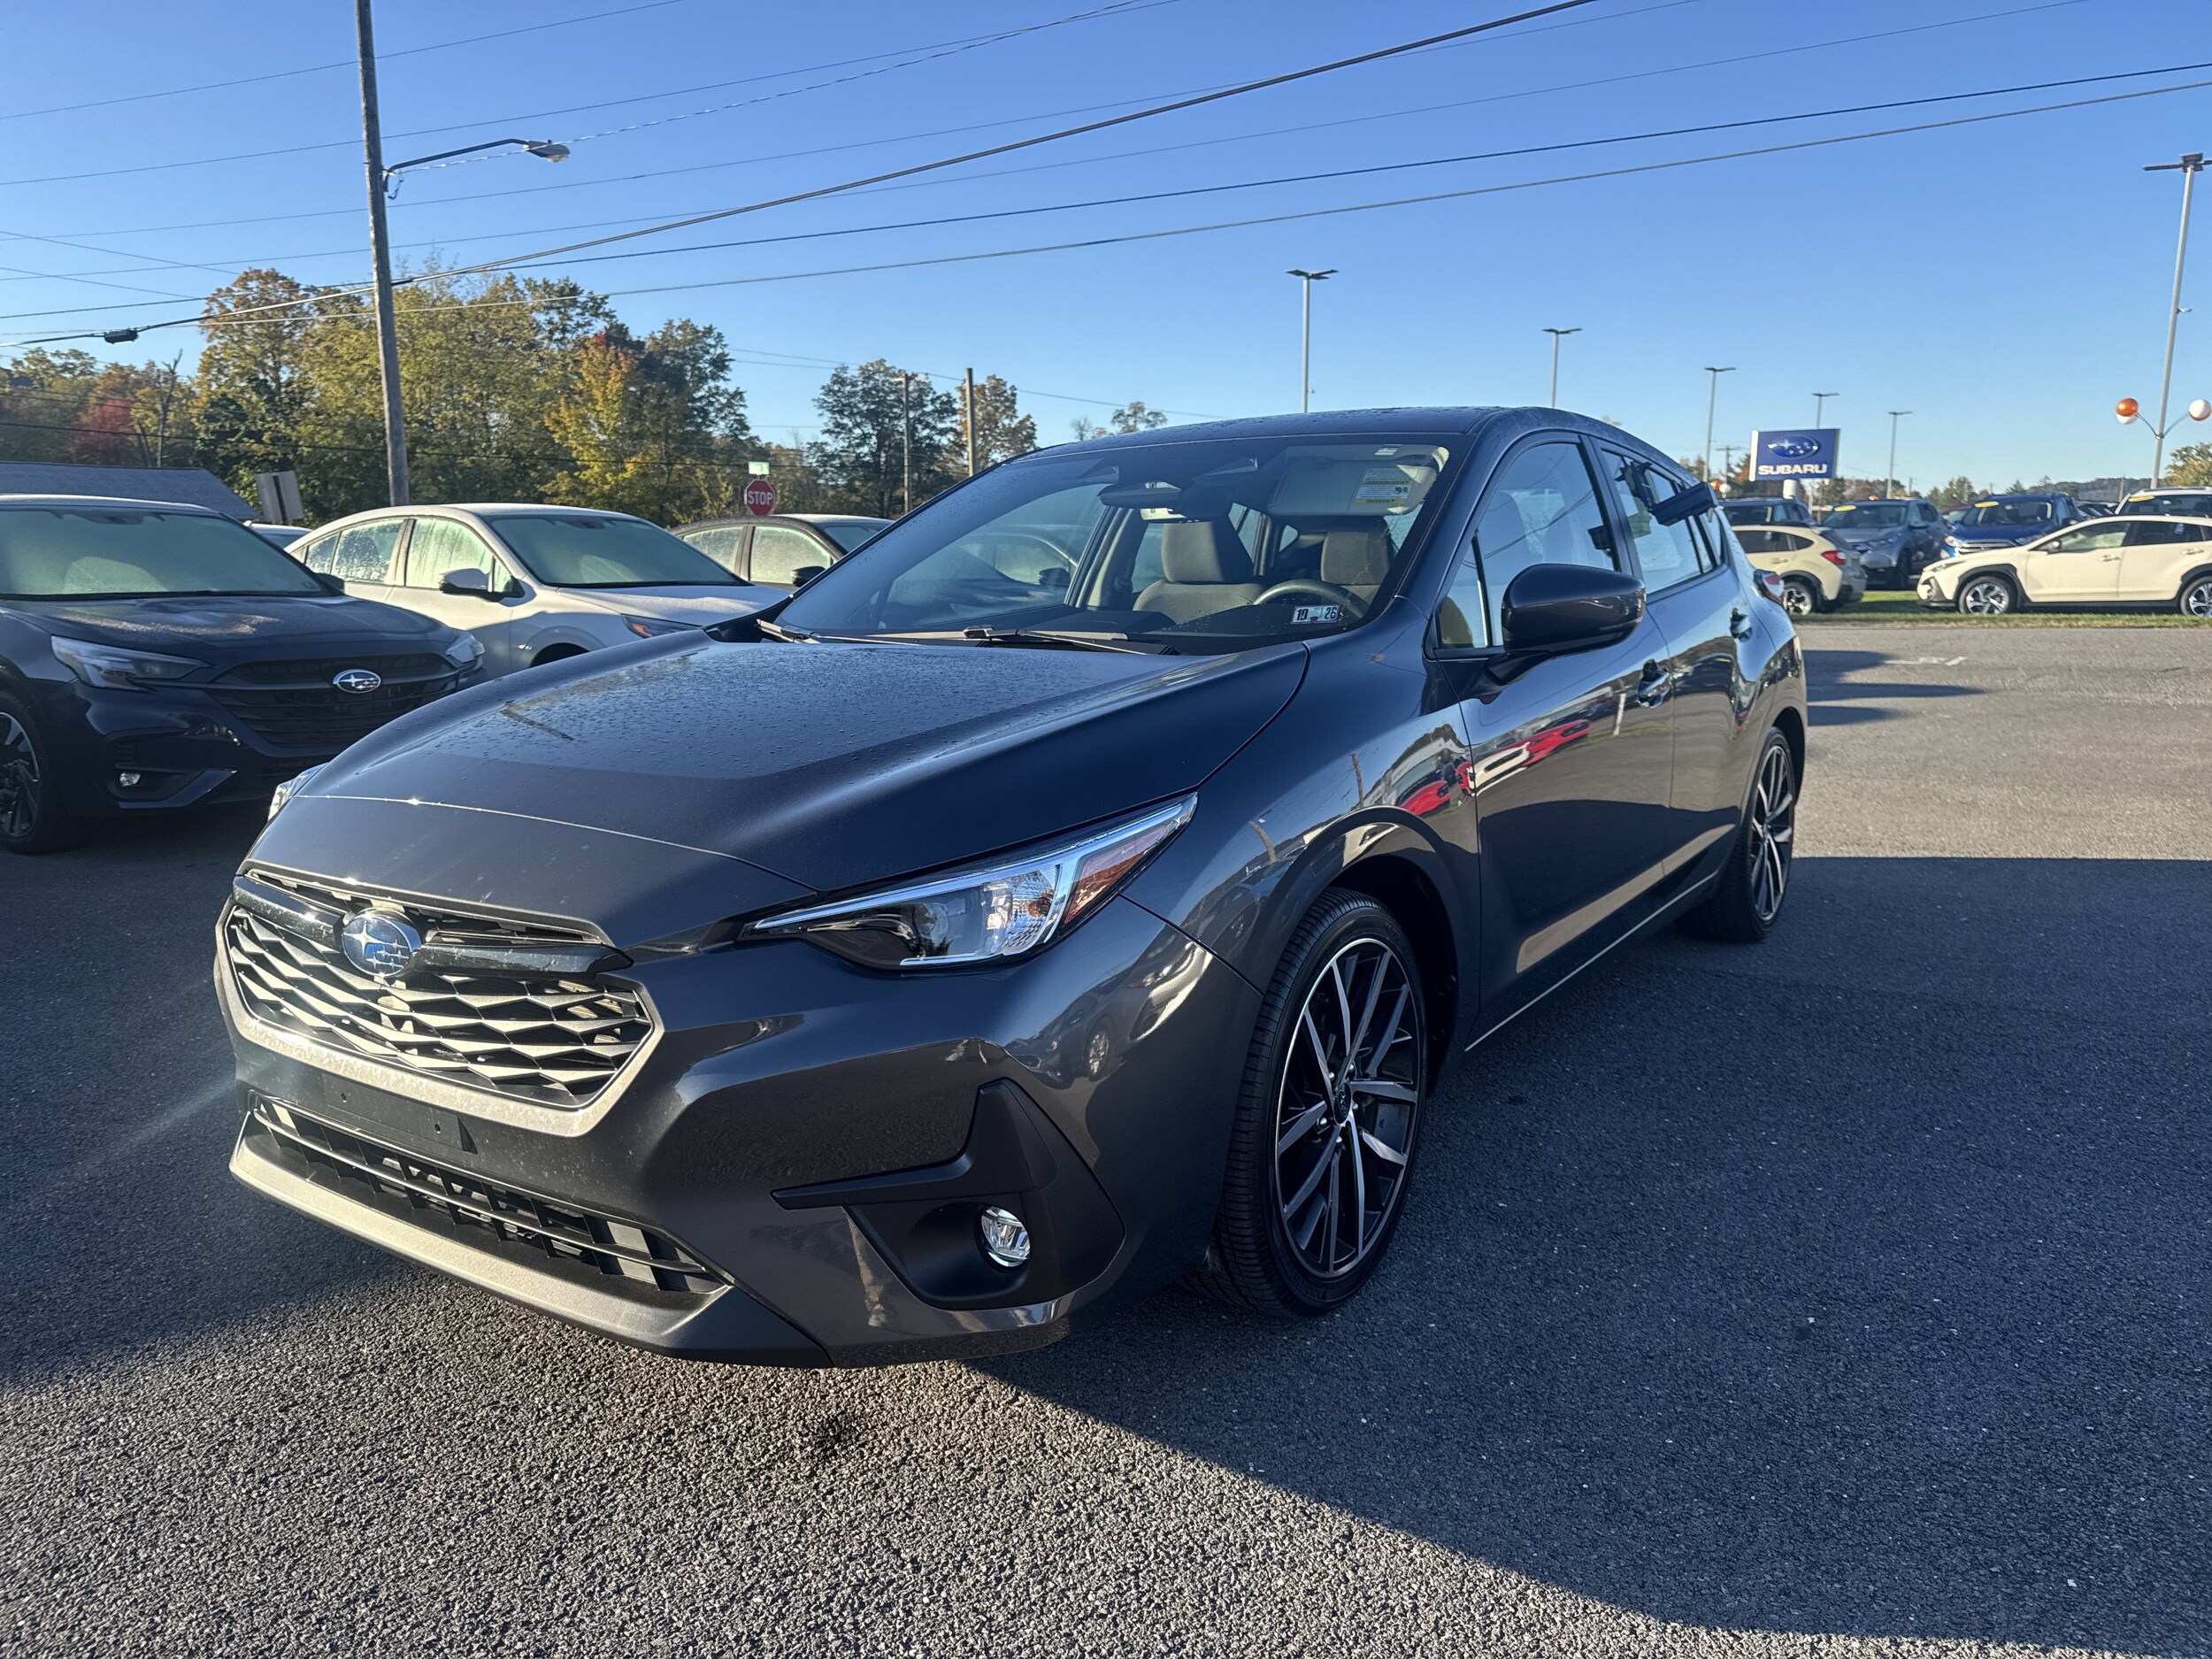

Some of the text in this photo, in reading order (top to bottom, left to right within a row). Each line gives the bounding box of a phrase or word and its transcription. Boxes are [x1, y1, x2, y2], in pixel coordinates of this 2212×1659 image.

[1758, 464, 1828, 475] SUBARU
[748, 491, 773, 505] STOP
[1325, 607, 1337, 619] 26
